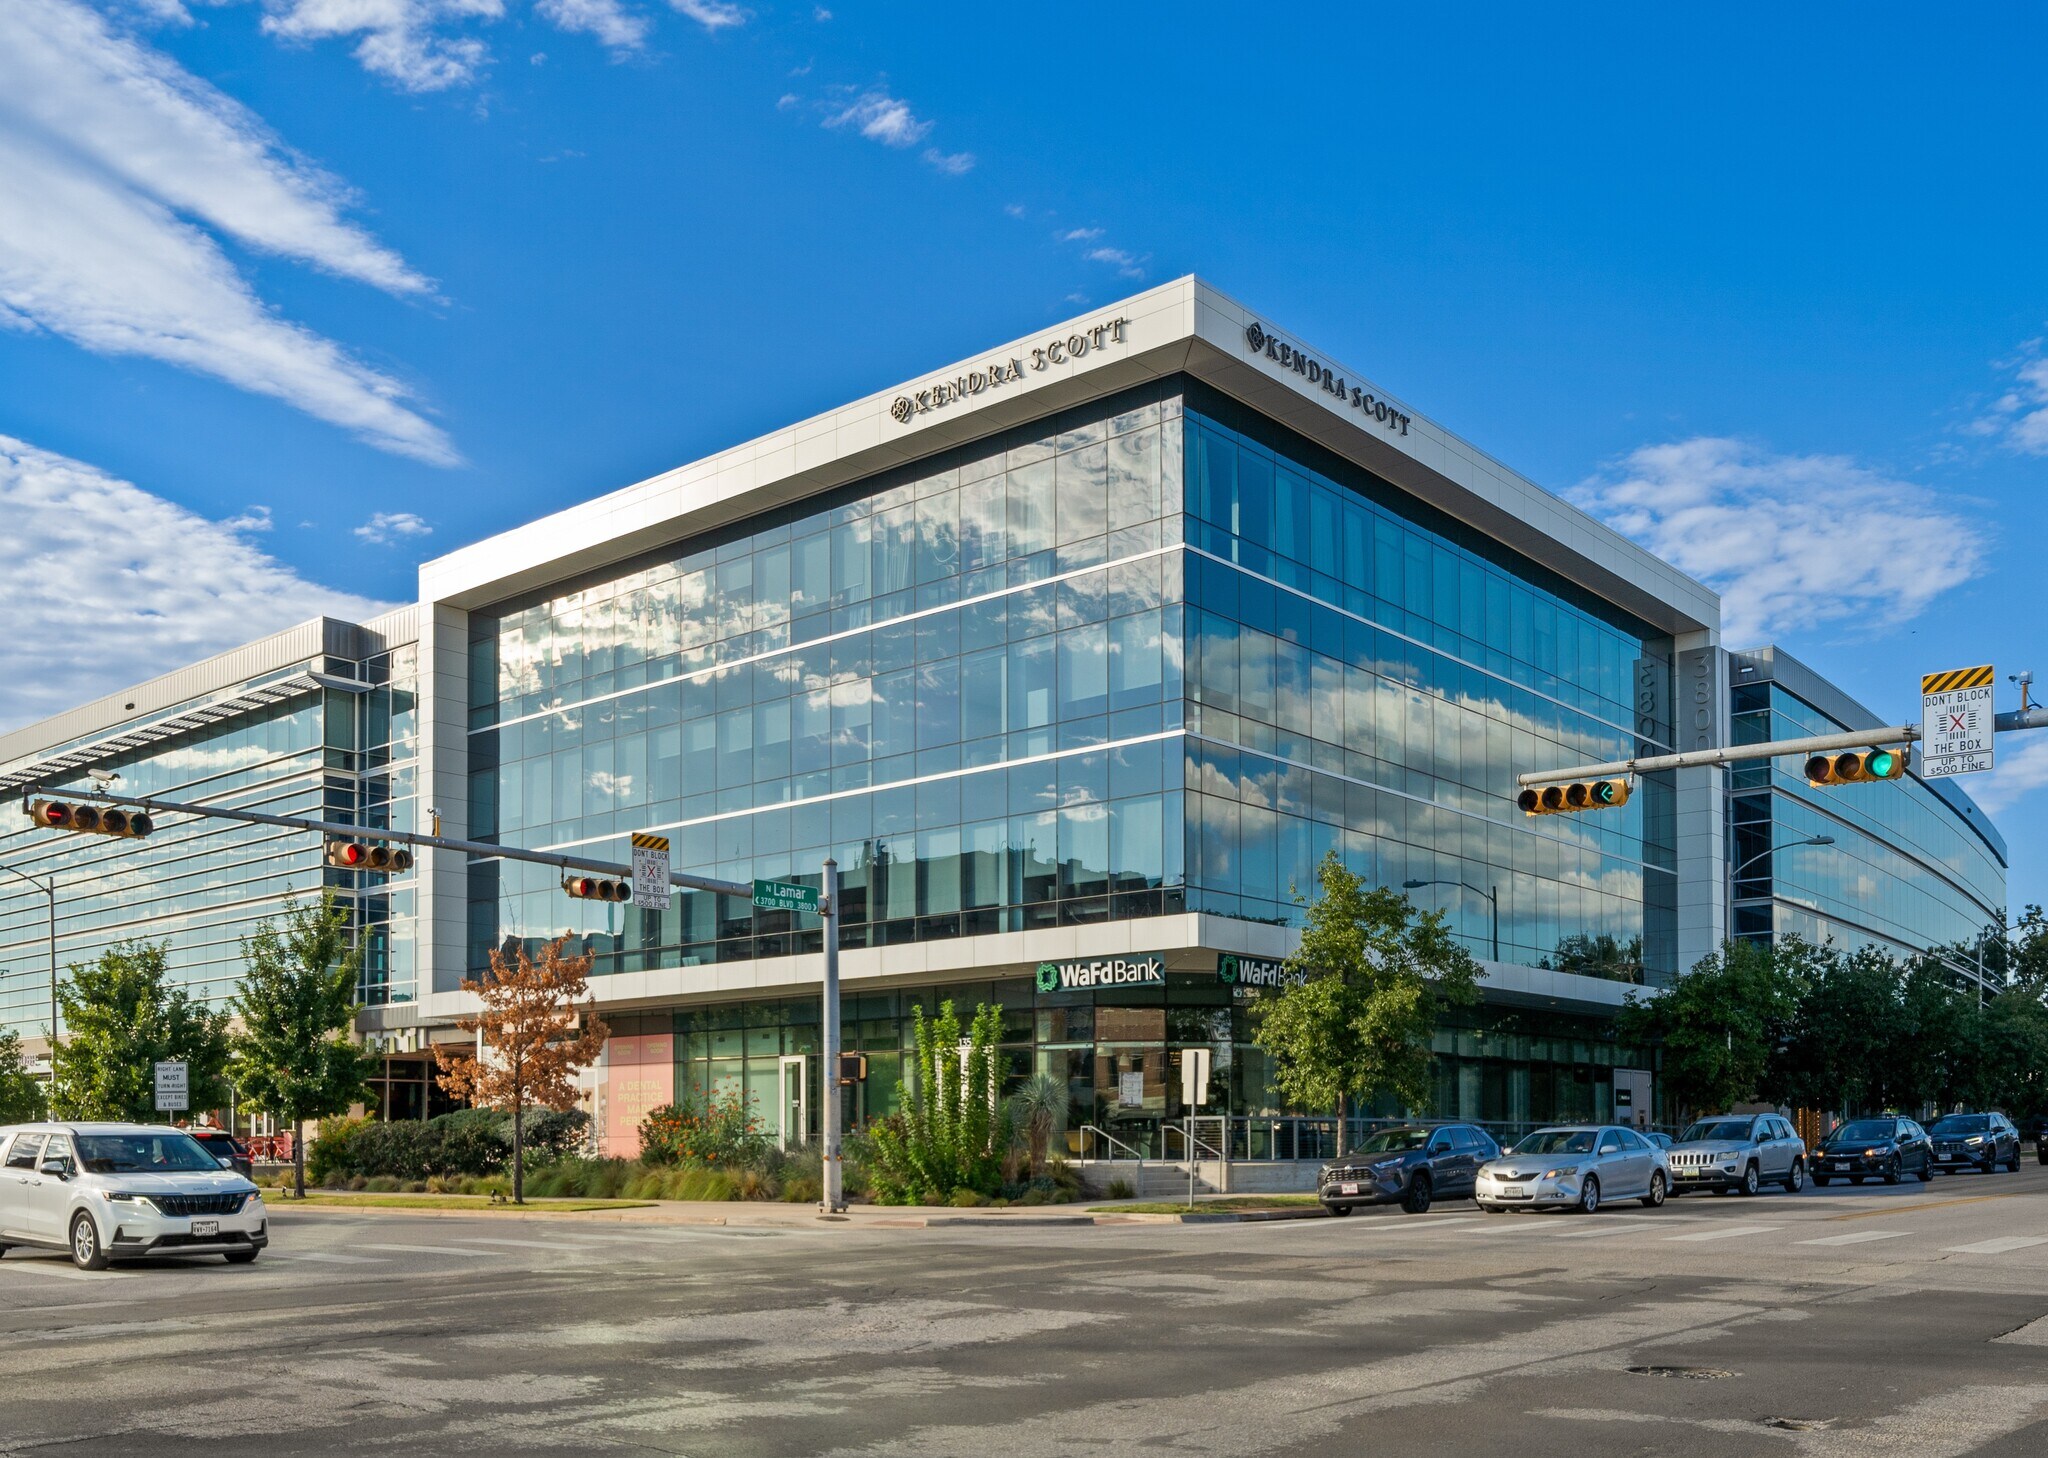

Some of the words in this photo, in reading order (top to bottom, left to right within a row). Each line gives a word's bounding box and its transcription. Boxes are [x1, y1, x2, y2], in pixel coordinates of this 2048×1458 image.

[912, 357, 1021, 414] KENDRA
[1030, 316, 1127, 371] SCOTT
[1265, 334, 1347, 400] KENDRA
[1351, 386, 1410, 436] SCOTT
[1957, 688, 1990, 703] BLOCK
[1934, 742, 1954, 754] THE
[1960, 739, 1981, 751] BOX
[1941, 757, 1955, 766] UP
[1960, 755, 1974, 763] TO
[1930, 765, 1957, 775] $500
[1961, 761, 1985, 771] FINE
[651, 851, 668, 861] BLOCK
[640, 884, 650, 892] THE
[653, 885, 664, 894] BOX
[765, 885, 771, 893] N
[774, 884, 806, 899] Lamar
[760, 897, 775, 906] 3700
[779, 899, 793, 908] BLVD
[797, 902, 812, 911] 3800
[619, 1081, 625, 1090] A
[627, 1080, 662, 1090] DENTAL
[617, 1091, 664, 1102] PRACTICE
